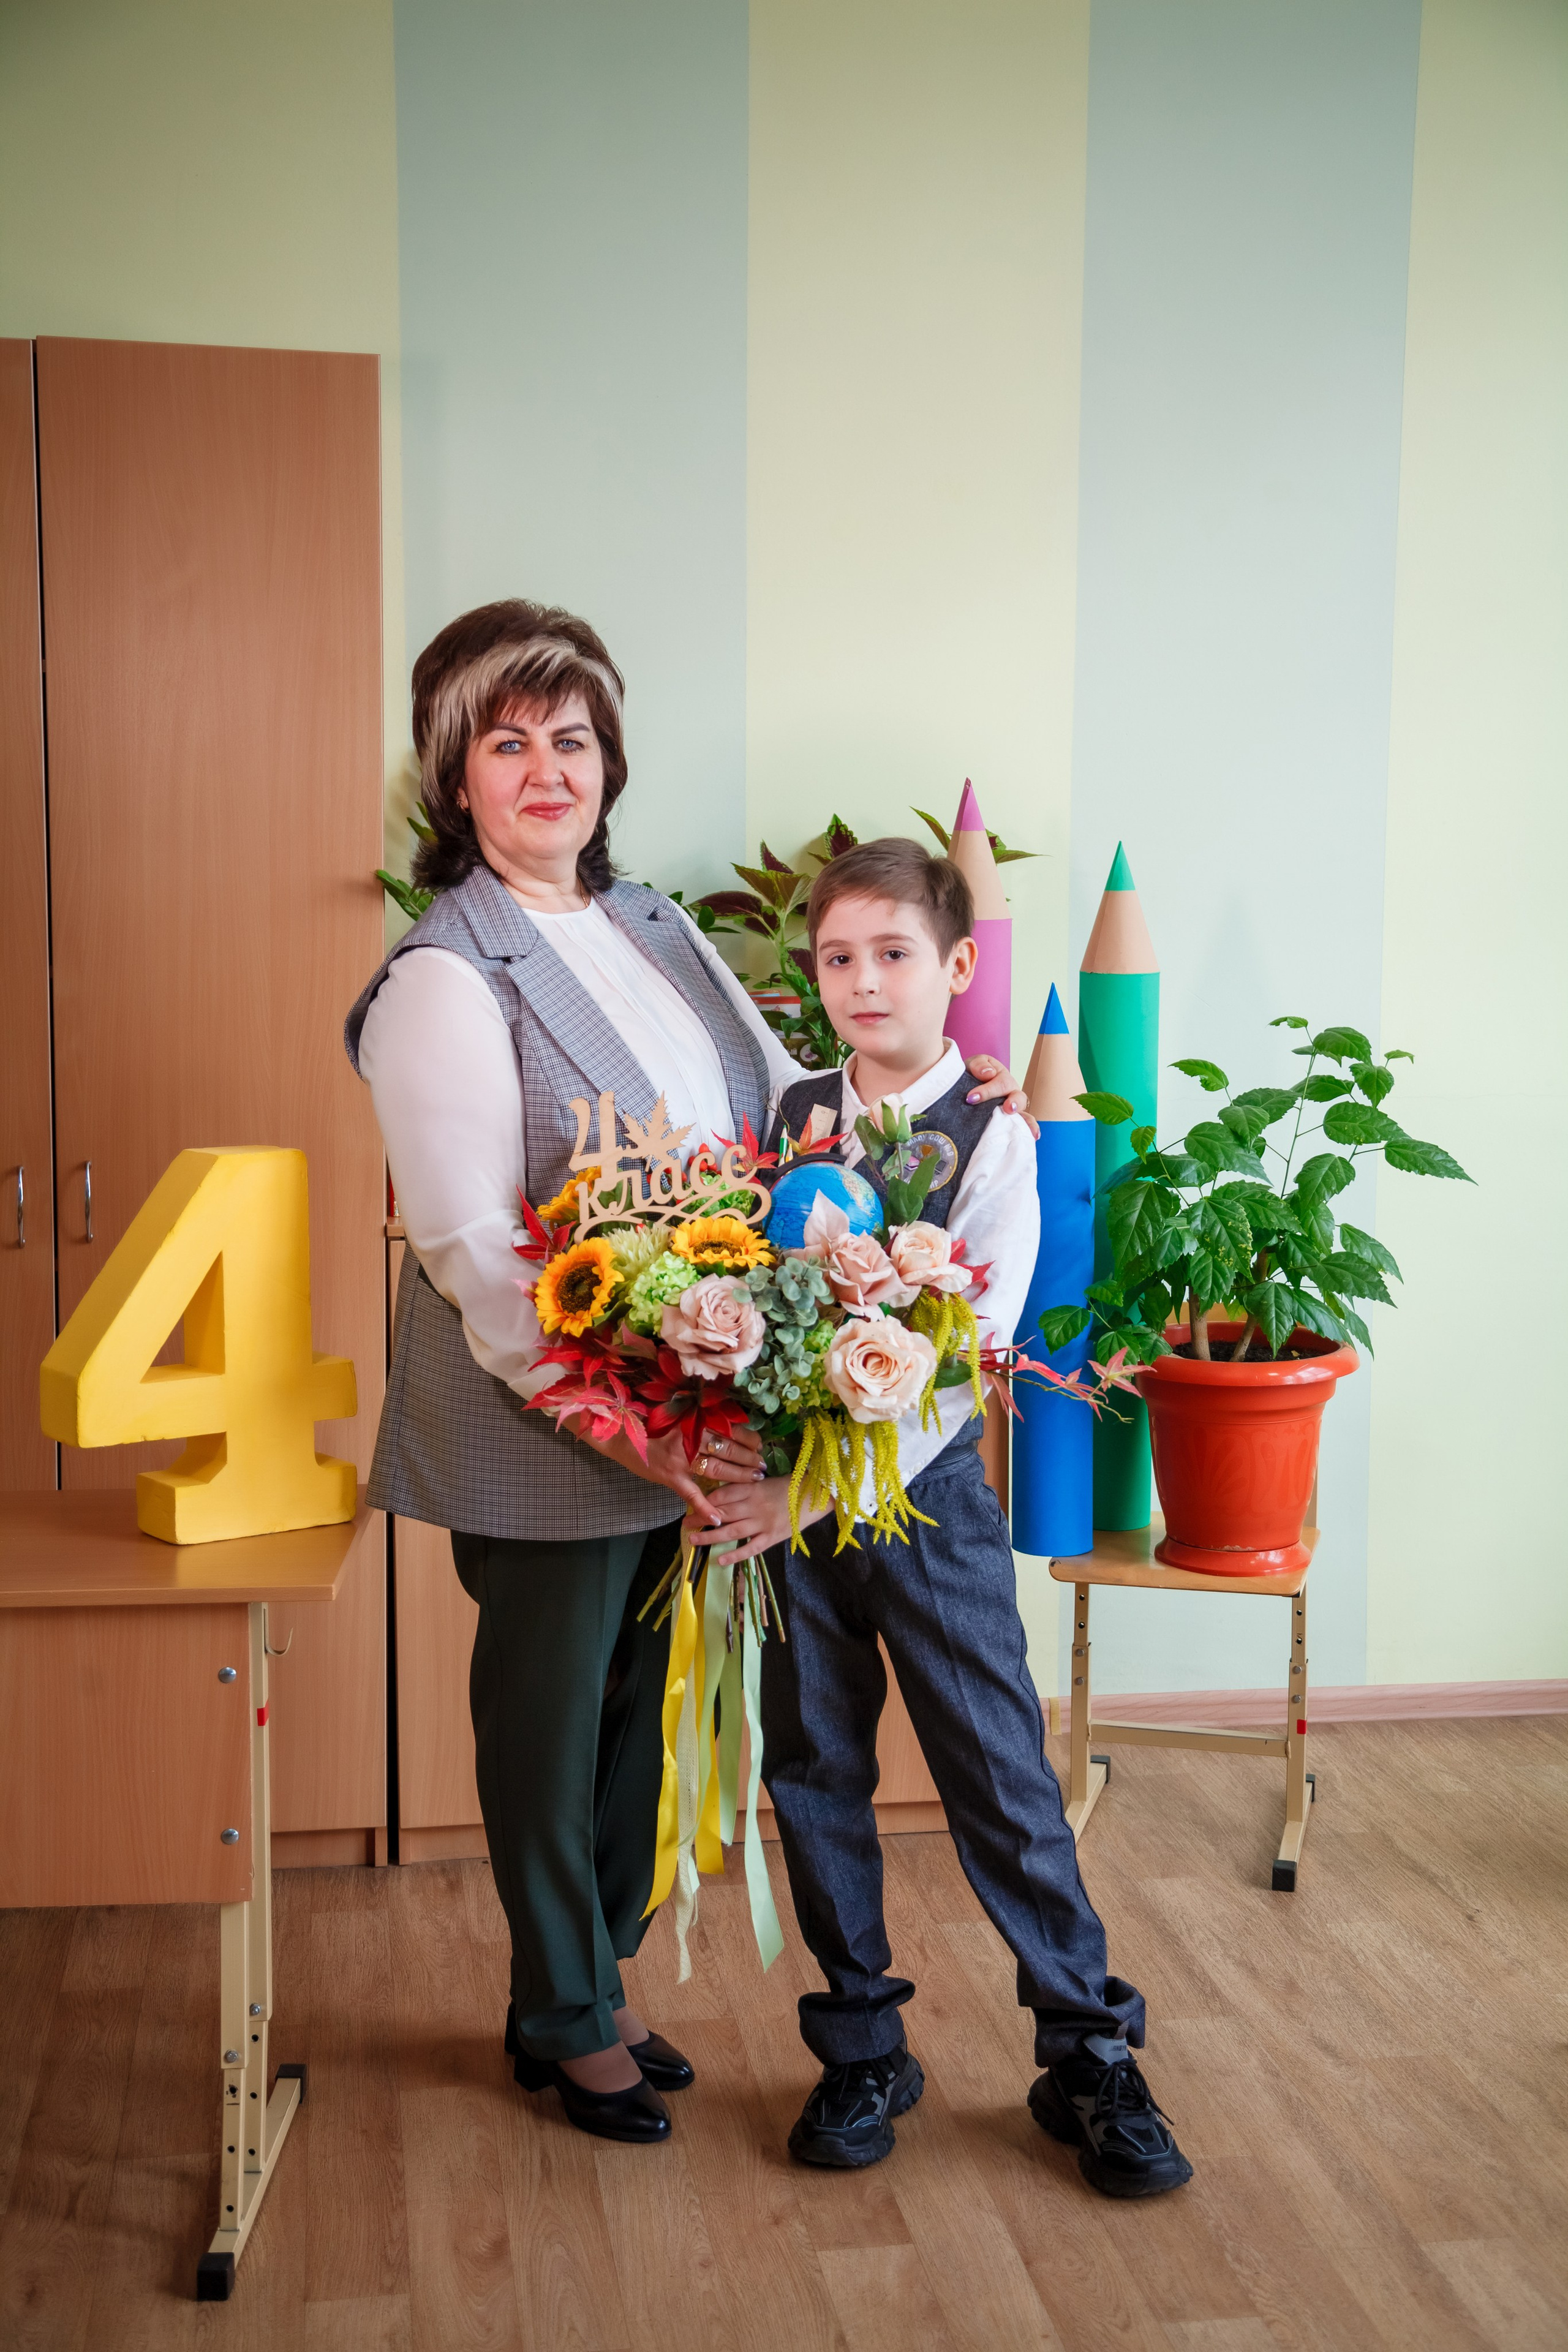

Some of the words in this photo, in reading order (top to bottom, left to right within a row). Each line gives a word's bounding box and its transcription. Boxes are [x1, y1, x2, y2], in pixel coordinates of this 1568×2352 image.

[568, 1090, 631, 1190] 4
[929, 1134, 946, 1145] СОШ
[40, 1145, 358, 1545] 4
